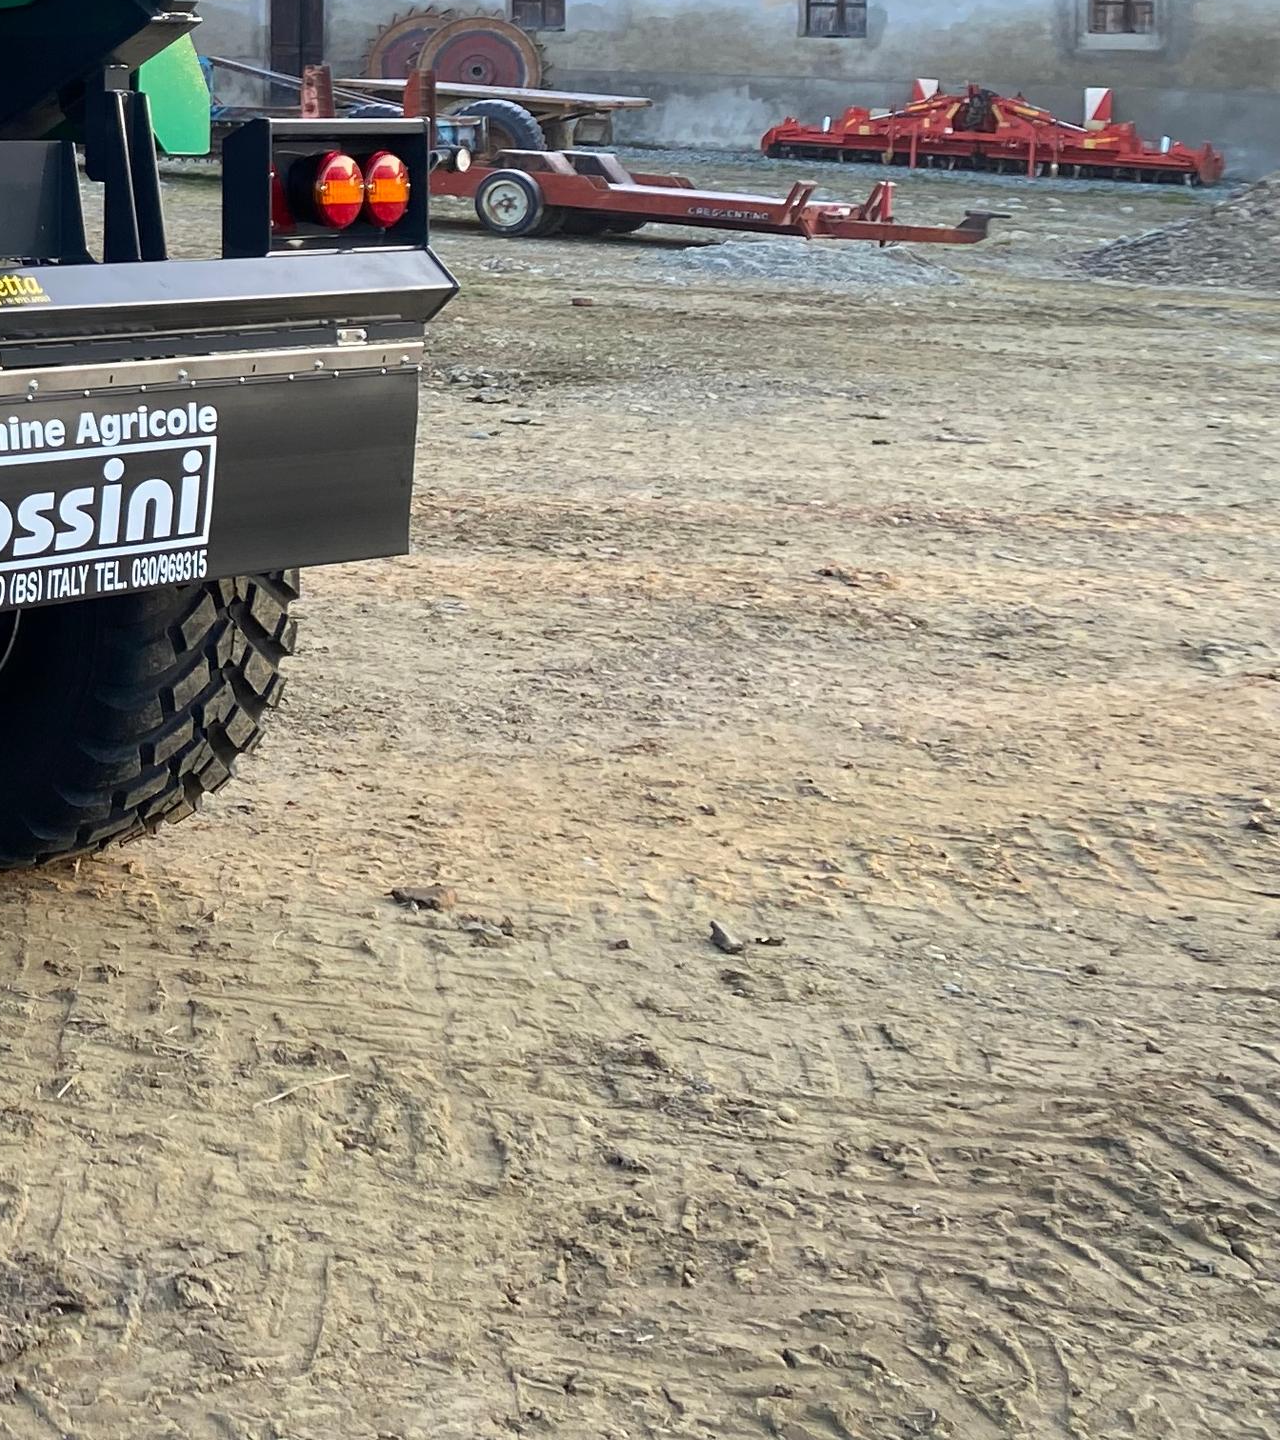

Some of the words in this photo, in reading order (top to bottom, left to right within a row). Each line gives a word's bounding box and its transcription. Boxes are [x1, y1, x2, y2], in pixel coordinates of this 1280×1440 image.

[75, 401, 219, 448] Agricole
[8, 569, 43, 608] (BS)
[46, 562, 91, 600] ITALY
[94, 558, 129, 593] TEL.
[131, 548, 209, 589] 030/969315
